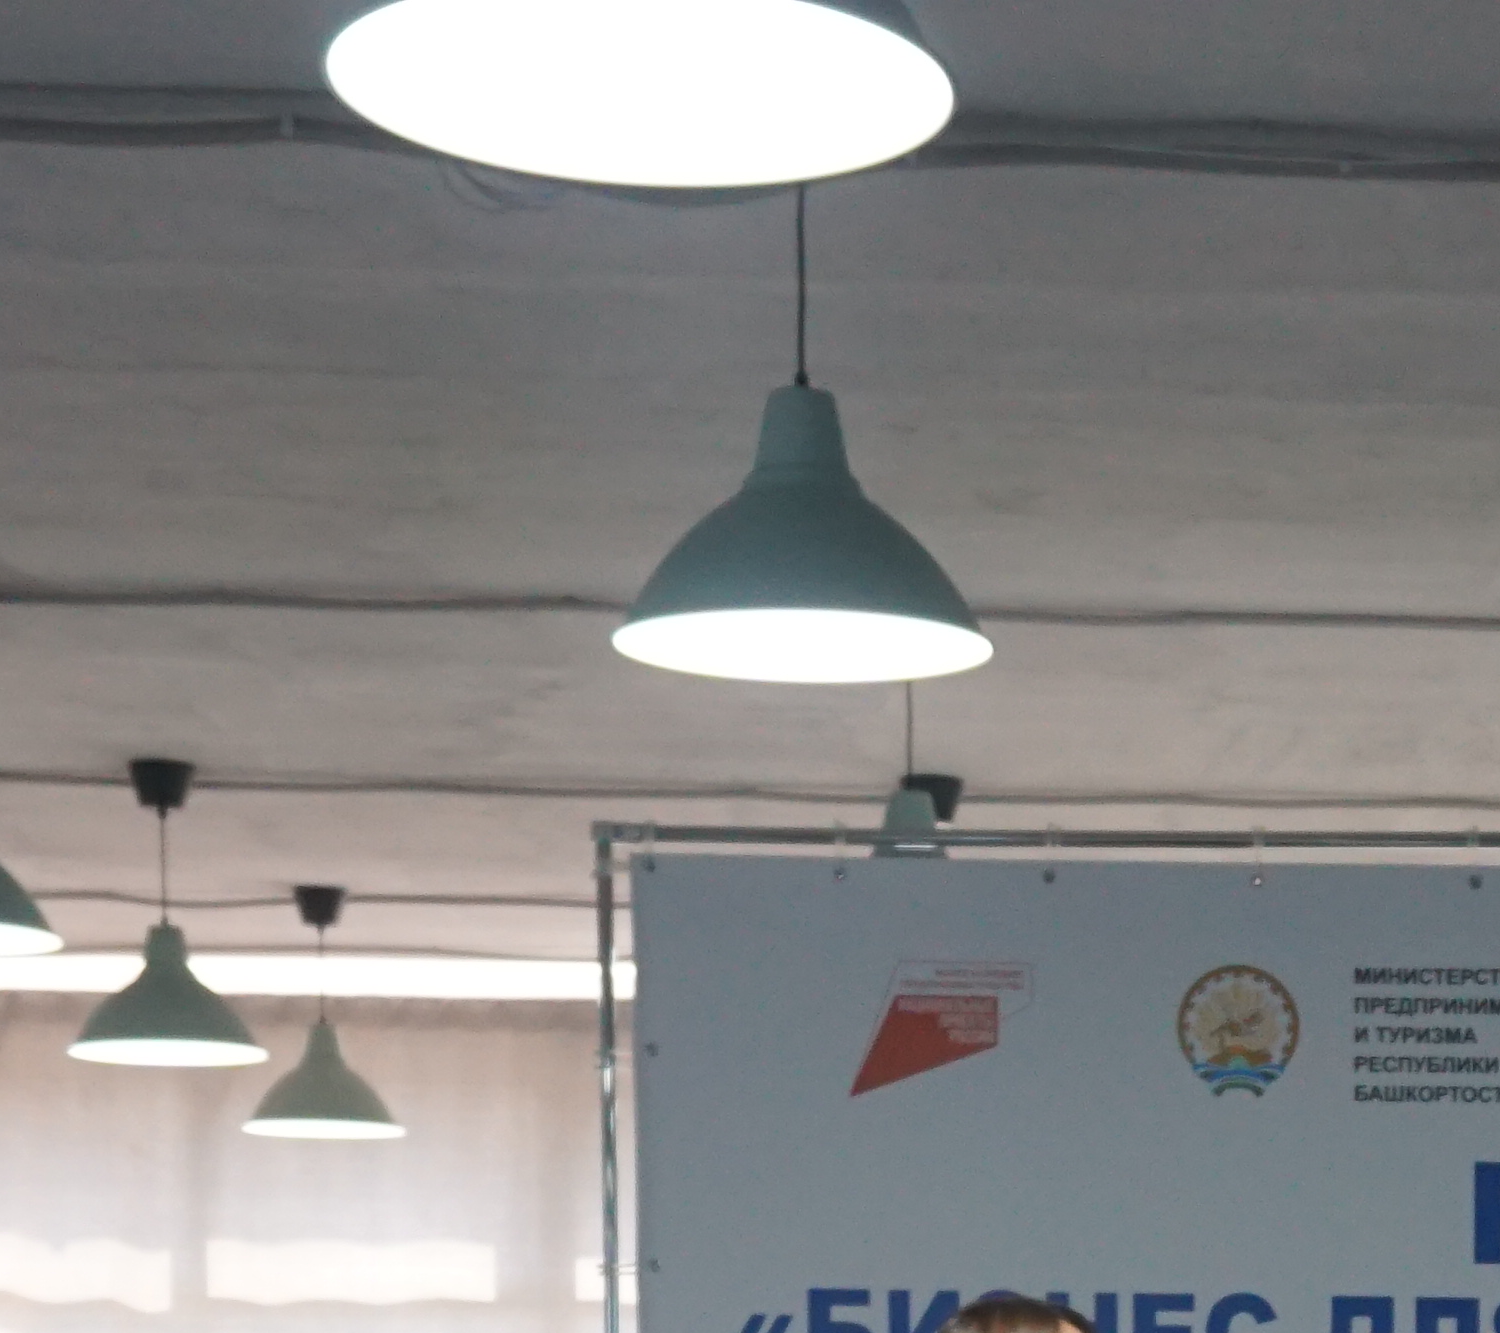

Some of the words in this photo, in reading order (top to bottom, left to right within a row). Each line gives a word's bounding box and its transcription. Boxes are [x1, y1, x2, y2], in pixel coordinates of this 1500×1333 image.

[1354, 1027, 1369, 1043] И
[1377, 1027, 1478, 1043] ТУРИЗМА
[1354, 1056, 1499, 1073] РЕСПУБЛИКИ
